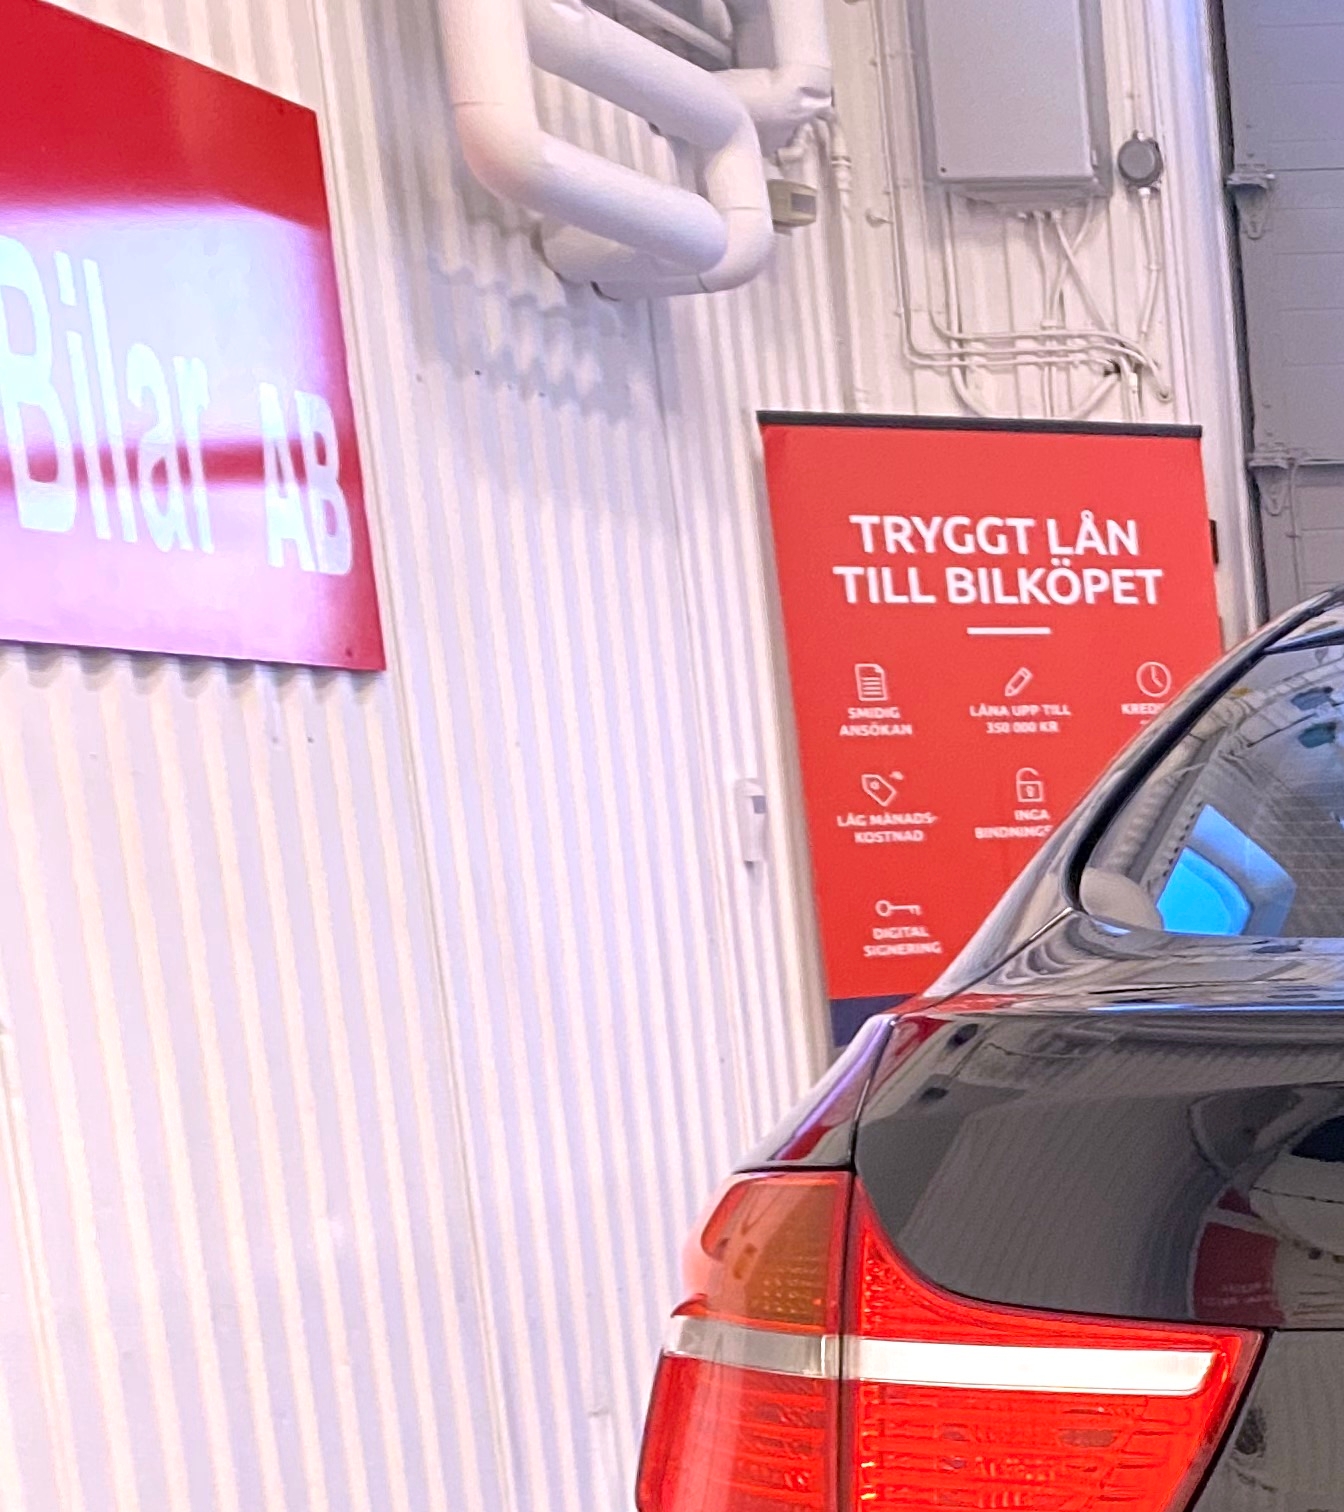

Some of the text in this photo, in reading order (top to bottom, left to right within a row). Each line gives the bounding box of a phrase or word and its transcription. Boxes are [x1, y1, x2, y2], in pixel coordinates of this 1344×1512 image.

[0, 234, 354, 576] Bilar AB
[850, 510, 1138, 555] TRYGGT LÅN
[833, 558, 1162, 604] TILL BILKÖPET
[848, 707, 900, 719] SMIDIG
[970, 704, 1071, 716] LÅNA UPP TILL
[840, 722, 912, 736] ANSÖKAN
[1013, 722, 1037, 732] 000
[1040, 721, 1058, 731] KR
[837, 813, 866, 826] LÅG
[1015, 809, 1049, 820] INGA
[855, 830, 923, 843] KOSTNAD
[873, 927, 929, 939] DIGITAL
[864, 942, 941, 956] SIGNERING
